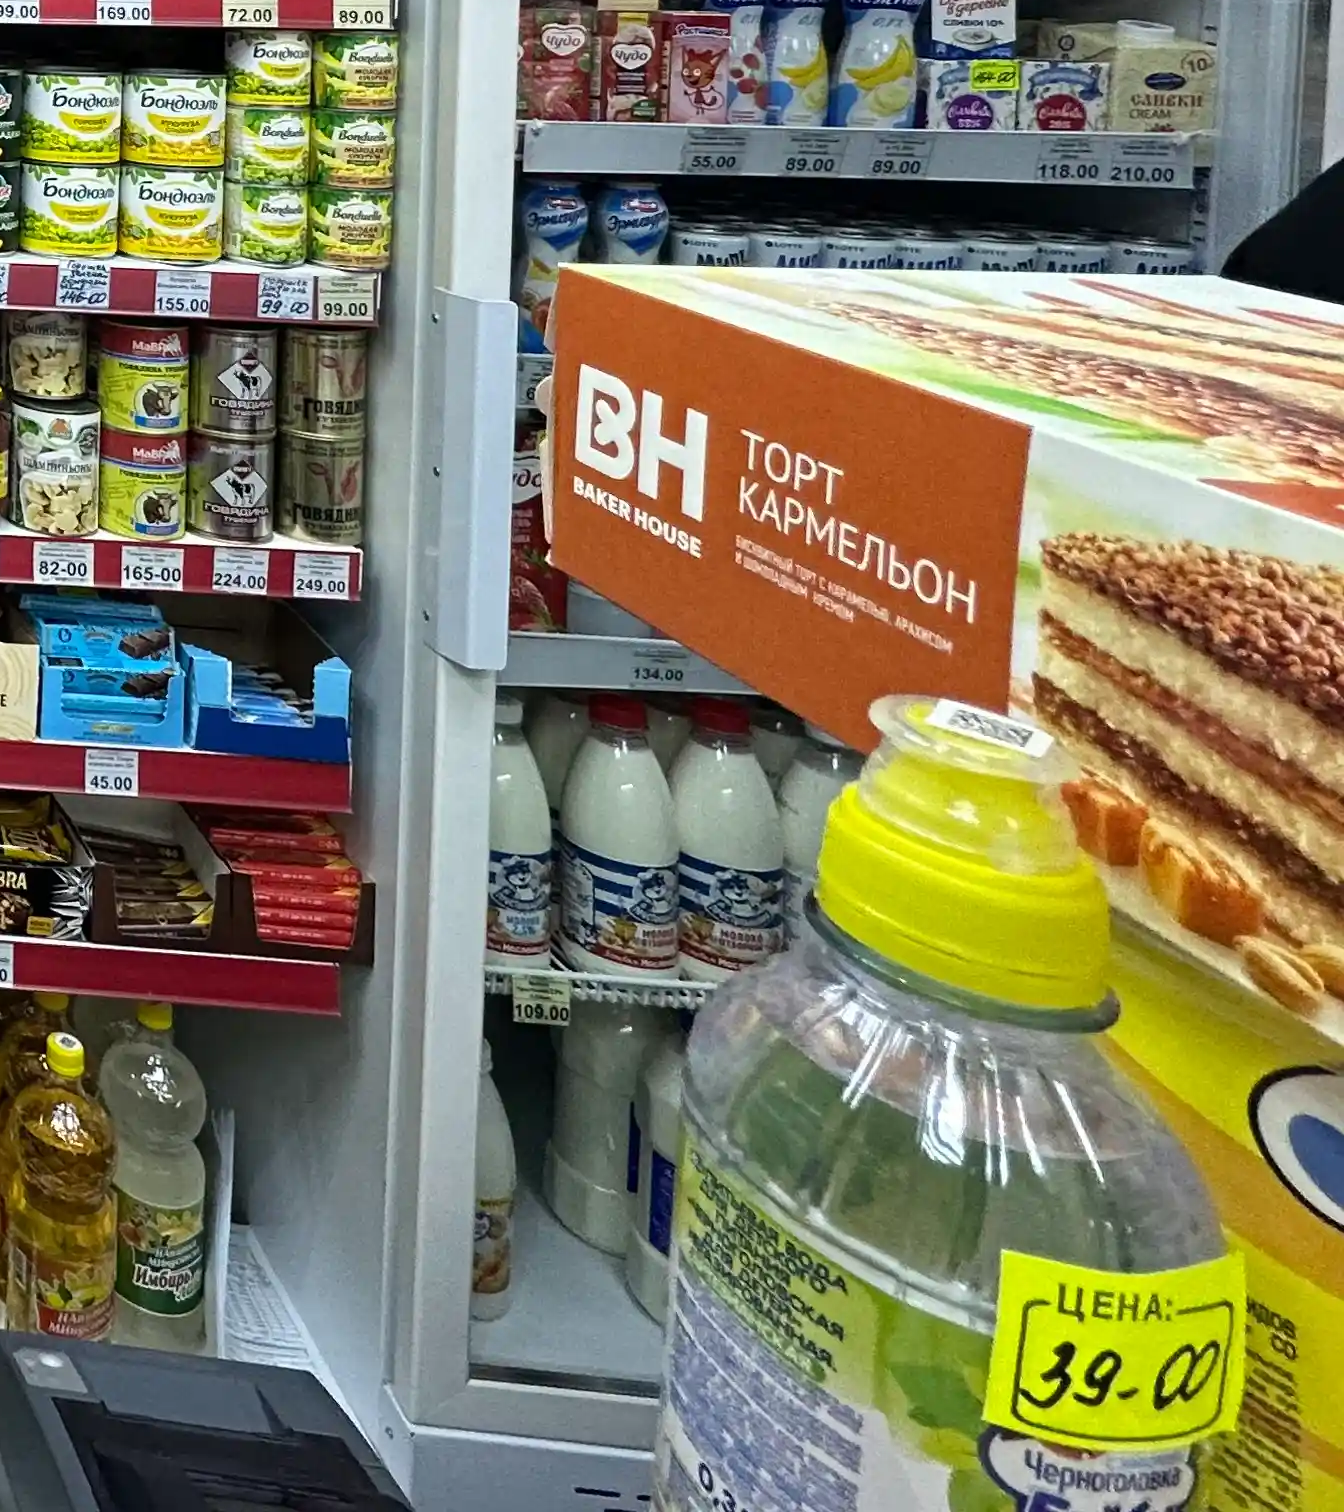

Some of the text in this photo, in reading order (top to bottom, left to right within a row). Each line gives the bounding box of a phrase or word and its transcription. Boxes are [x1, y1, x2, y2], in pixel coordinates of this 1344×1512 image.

[140, 91, 217, 115] Бондюэль
[1129, 93, 1204, 110] СЛИВКИ
[1129, 109, 1172, 121] CREAM
[1036, 162, 1100, 180] 118.00
[1111, 165, 1176, 184] 210.00
[156, 296, 209, 312] 155.00
[575, 361, 710, 523] BH
[740, 428, 845, 506] ТОРТ
[572, 476, 702, 559] BAKER HOUSE
[738, 476, 978, 625] КАРМЕЛЬОН
[39, 560, 87, 577] 82-00
[122, 565, 182, 582] 165-00
[89, 775, 133, 792] 45.00
[513, 1002, 570, 1023] 109.00
[1054, 1282, 1177, 1324] ЦЕНА:
[1021, 1335, 1221, 1410] 39-00
